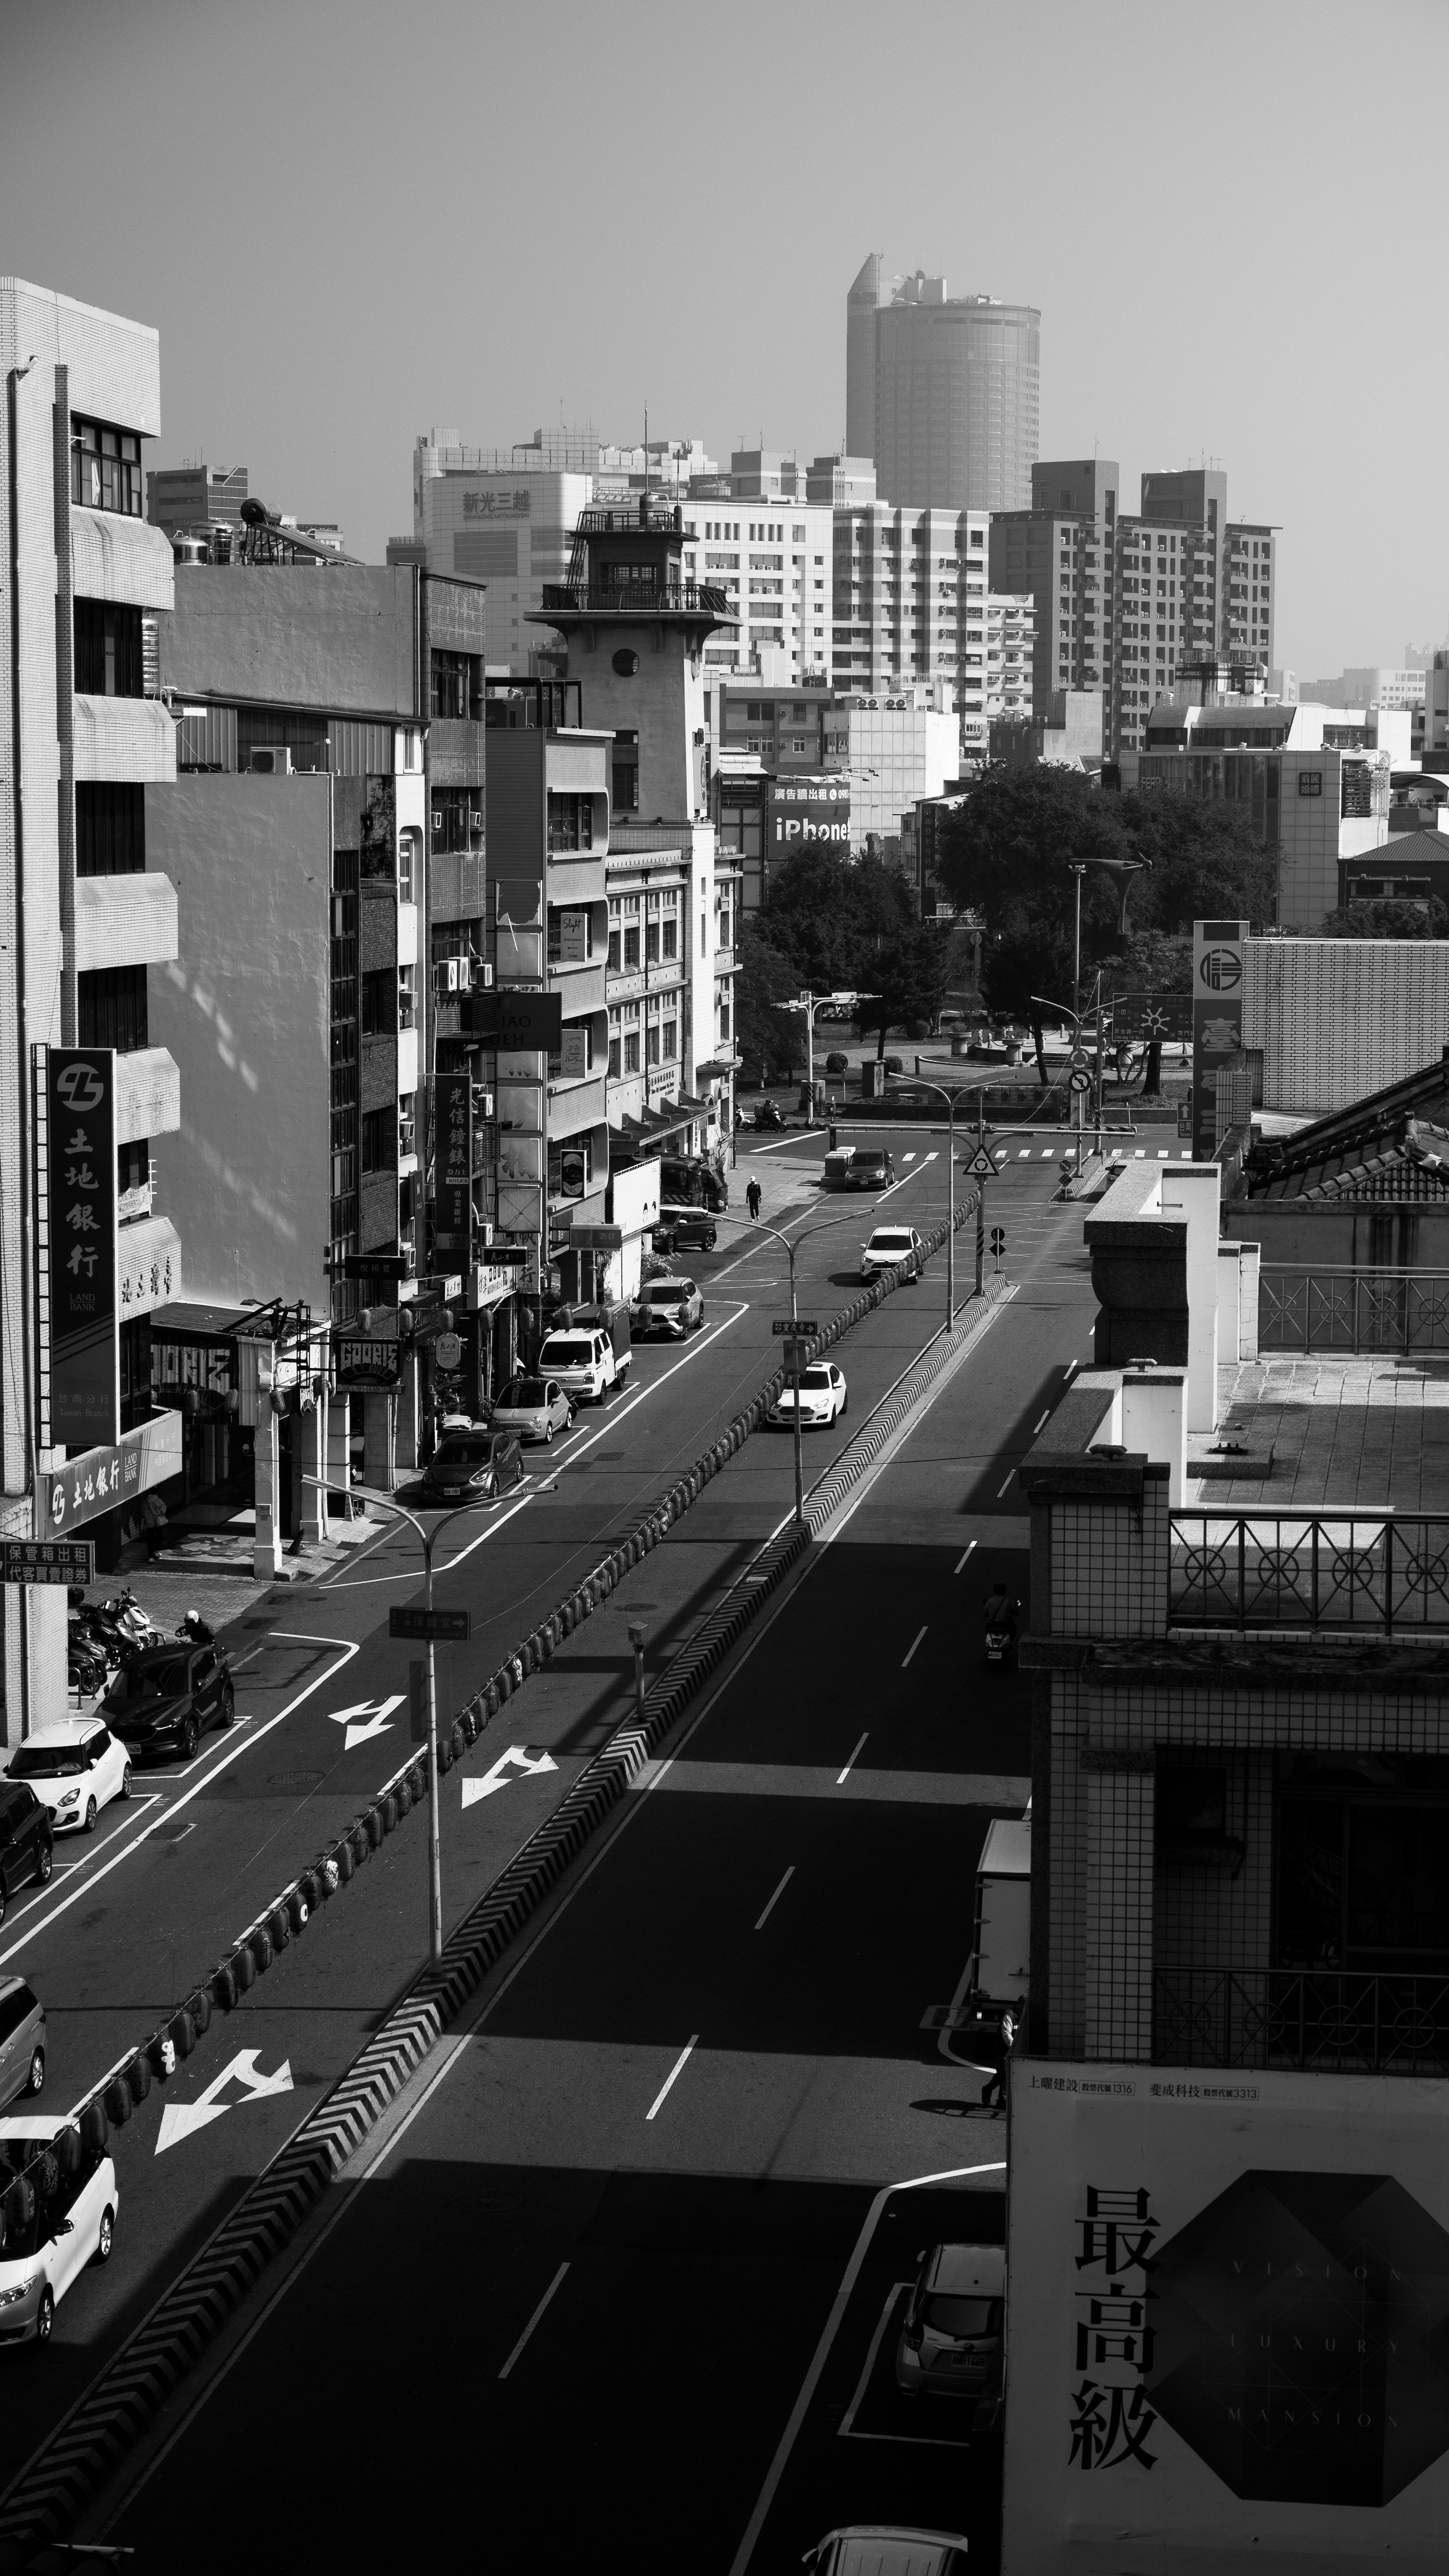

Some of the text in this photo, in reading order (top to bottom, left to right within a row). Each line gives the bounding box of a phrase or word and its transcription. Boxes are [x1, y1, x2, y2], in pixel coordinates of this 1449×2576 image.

[463, 490, 530, 513] 新光三越
[1301, 774, 1320, 784] 翡麗
[1301, 785, 1319, 794] 婚禮
[563, 918, 583, 933] Slight
[502, 1015, 531, 1027] IAO
[490, 1034, 524, 1045] UEH
[448, 1087, 466, 1165] 光信鐘錶
[1179, 1122, 1191, 1131] 台南
[64, 1128, 101, 1278] 土地銀行
[517, 1233, 536, 1284] 帆行
[69, 1293, 95, 1301] LAND
[70, 1303, 95, 1311] BANK
[58, 1394, 108, 1404] 台南分行
[85, 1409, 109, 1417] Branch
[124, 1453, 137, 1468] LAND
[125, 1468, 137, 1483] BANK
[72, 1458, 119, 1509] 土地銀行
[9, 1545, 86, 1562] 保管箱出租
[9, 1565, 87, 1583] 代客買賣證券
[413, 1615, 452, 1628] 擇賢堂
[1029, 2076, 1133, 2094] 上曜建設 股票代號1316
[1203, 2088, 1257, 2100] 股票代號3313
[1234, 2260, 1401, 2282] VISION
[1068, 2184, 1162, 2470] 最高級
[1230, 2332, 1399, 2355] LUXURY
[1228, 2406, 1398, 2429] MANSION
